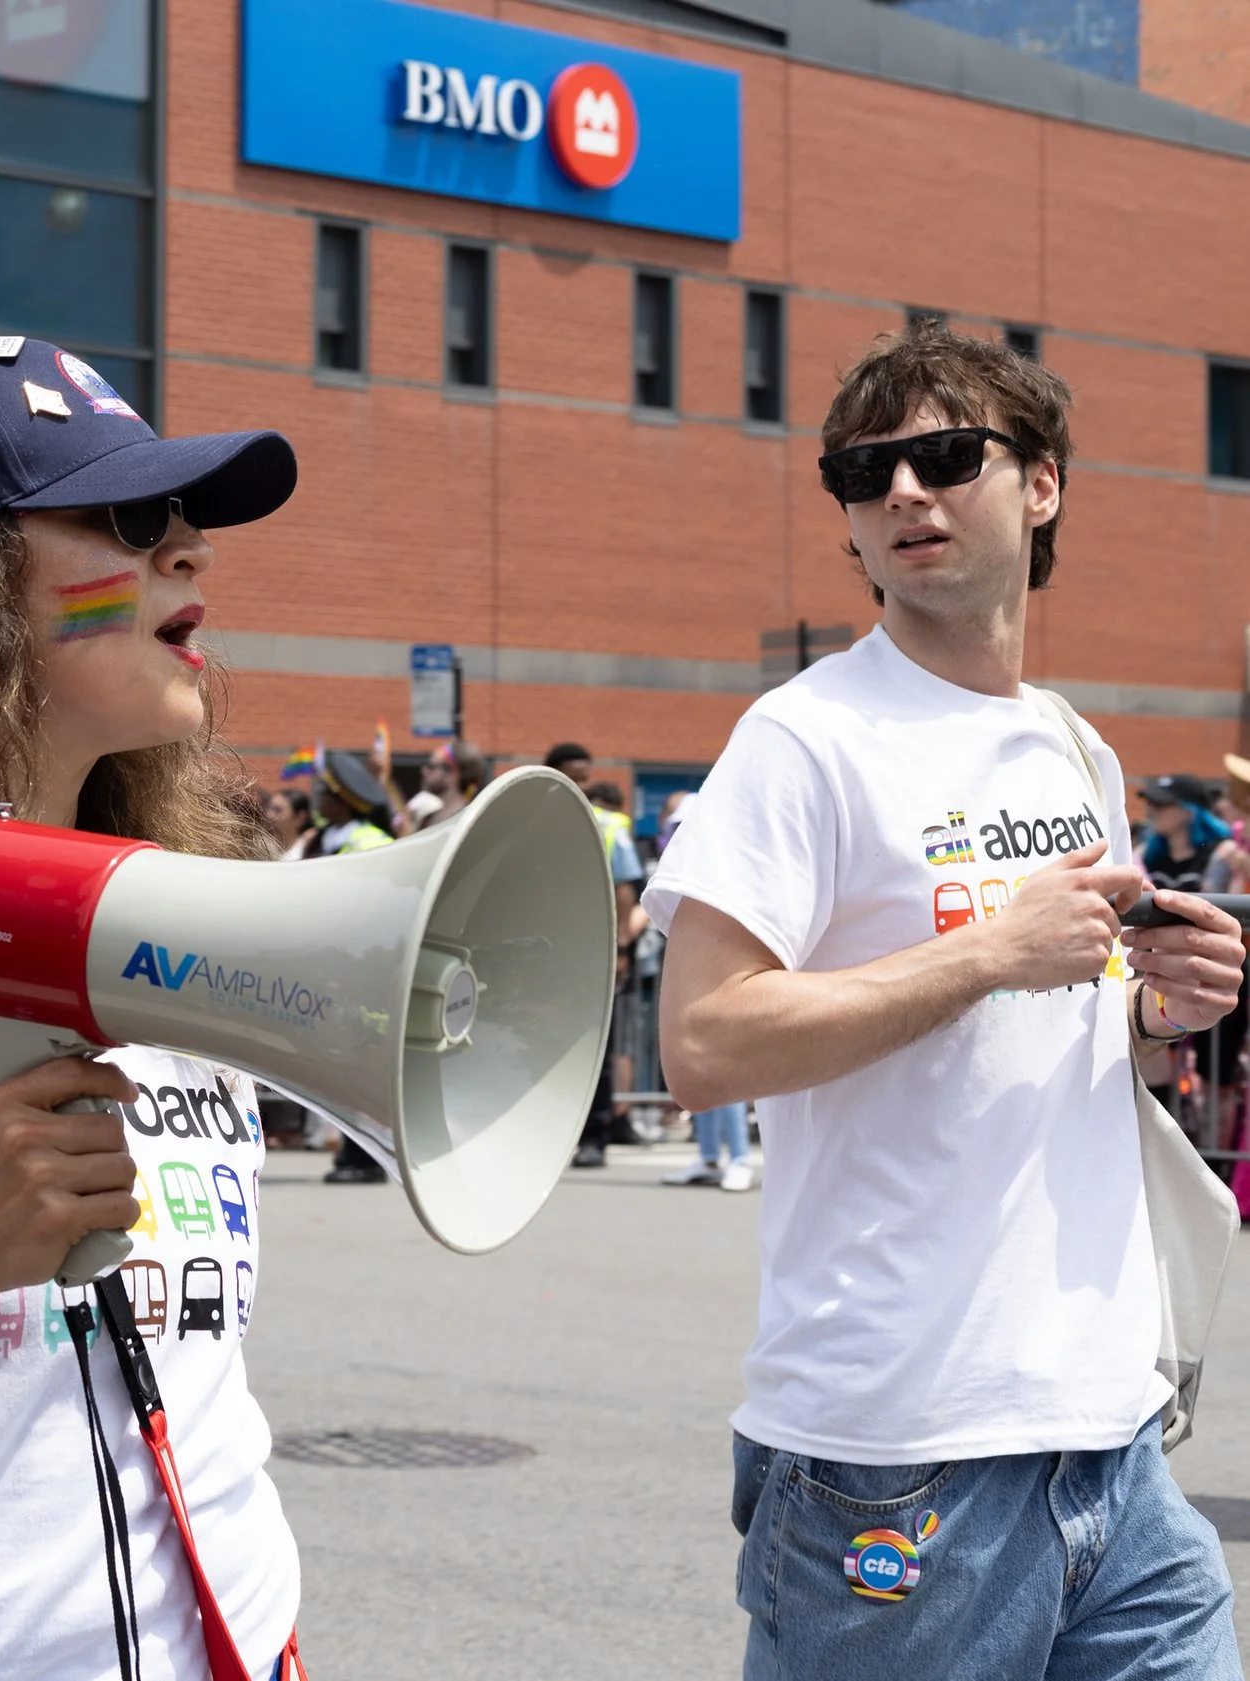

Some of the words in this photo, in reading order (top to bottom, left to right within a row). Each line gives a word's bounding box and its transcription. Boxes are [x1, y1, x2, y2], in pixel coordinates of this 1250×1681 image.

[403, 59, 544, 141] BMO
[921, 811, 976, 866] all
[979, 802, 1104, 861] aboard
[122, 1076, 252, 1145] oard
[863, 1557, 900, 1577] cta
